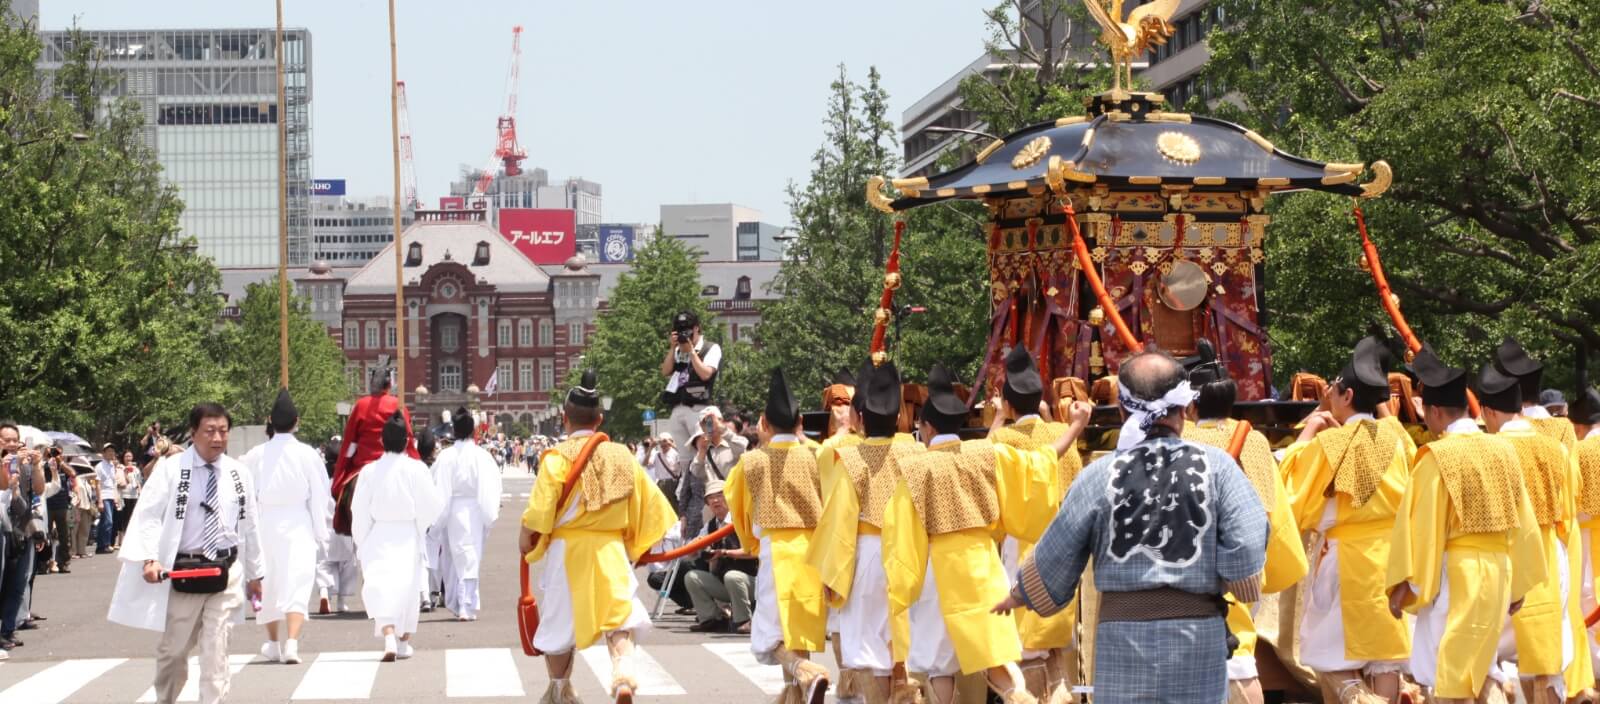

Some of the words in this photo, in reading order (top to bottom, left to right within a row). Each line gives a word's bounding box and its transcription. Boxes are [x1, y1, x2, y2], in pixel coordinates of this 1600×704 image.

[509, 230, 565, 246] アールエフ
[175, 469, 191, 520] 日枝神社
